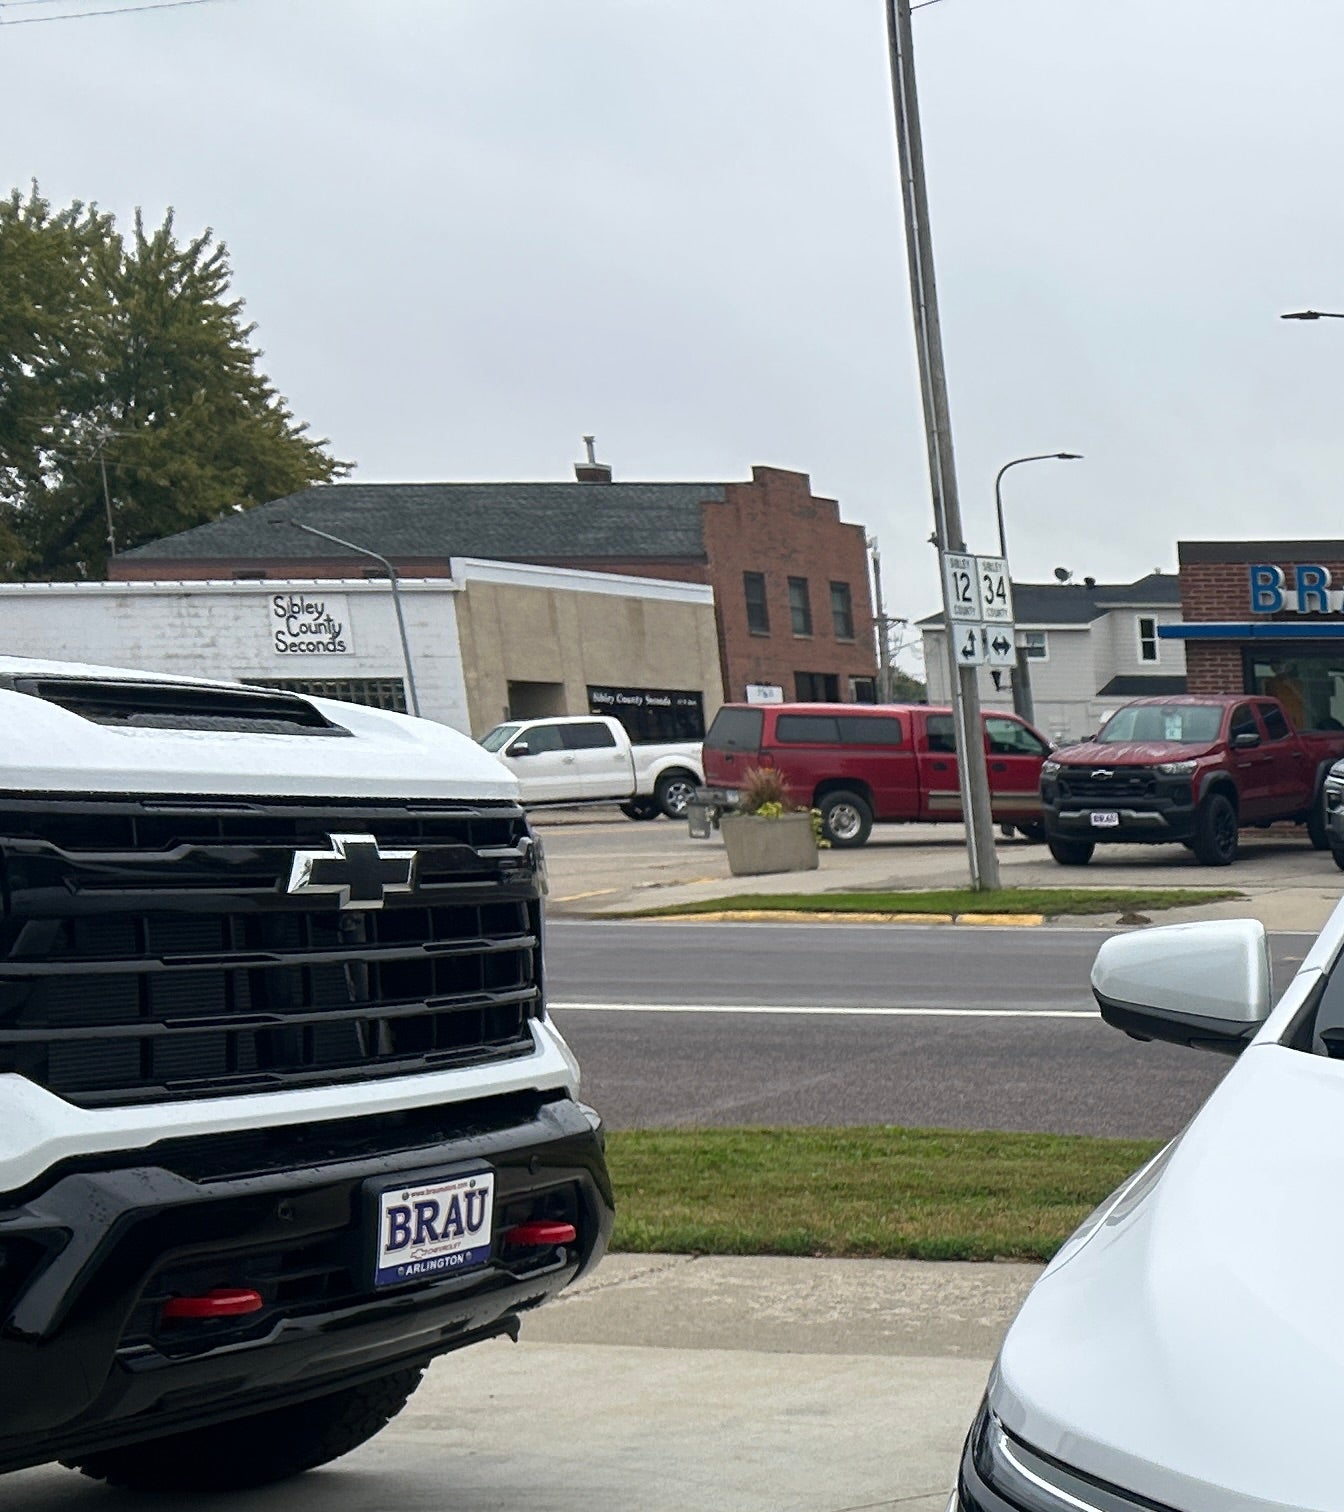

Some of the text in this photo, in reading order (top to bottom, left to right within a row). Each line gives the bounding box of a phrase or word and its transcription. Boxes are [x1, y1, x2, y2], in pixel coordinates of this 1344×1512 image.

[952, 571, 972, 602] 12
[984, 574, 1006, 604] 34
[273, 595, 325, 621] Sibley
[286, 613, 343, 640] County
[275, 630, 347, 653] Seconds
[384, 1187, 488, 1254] BRAU
[405, 1253, 464, 1276] ARLINGTON
